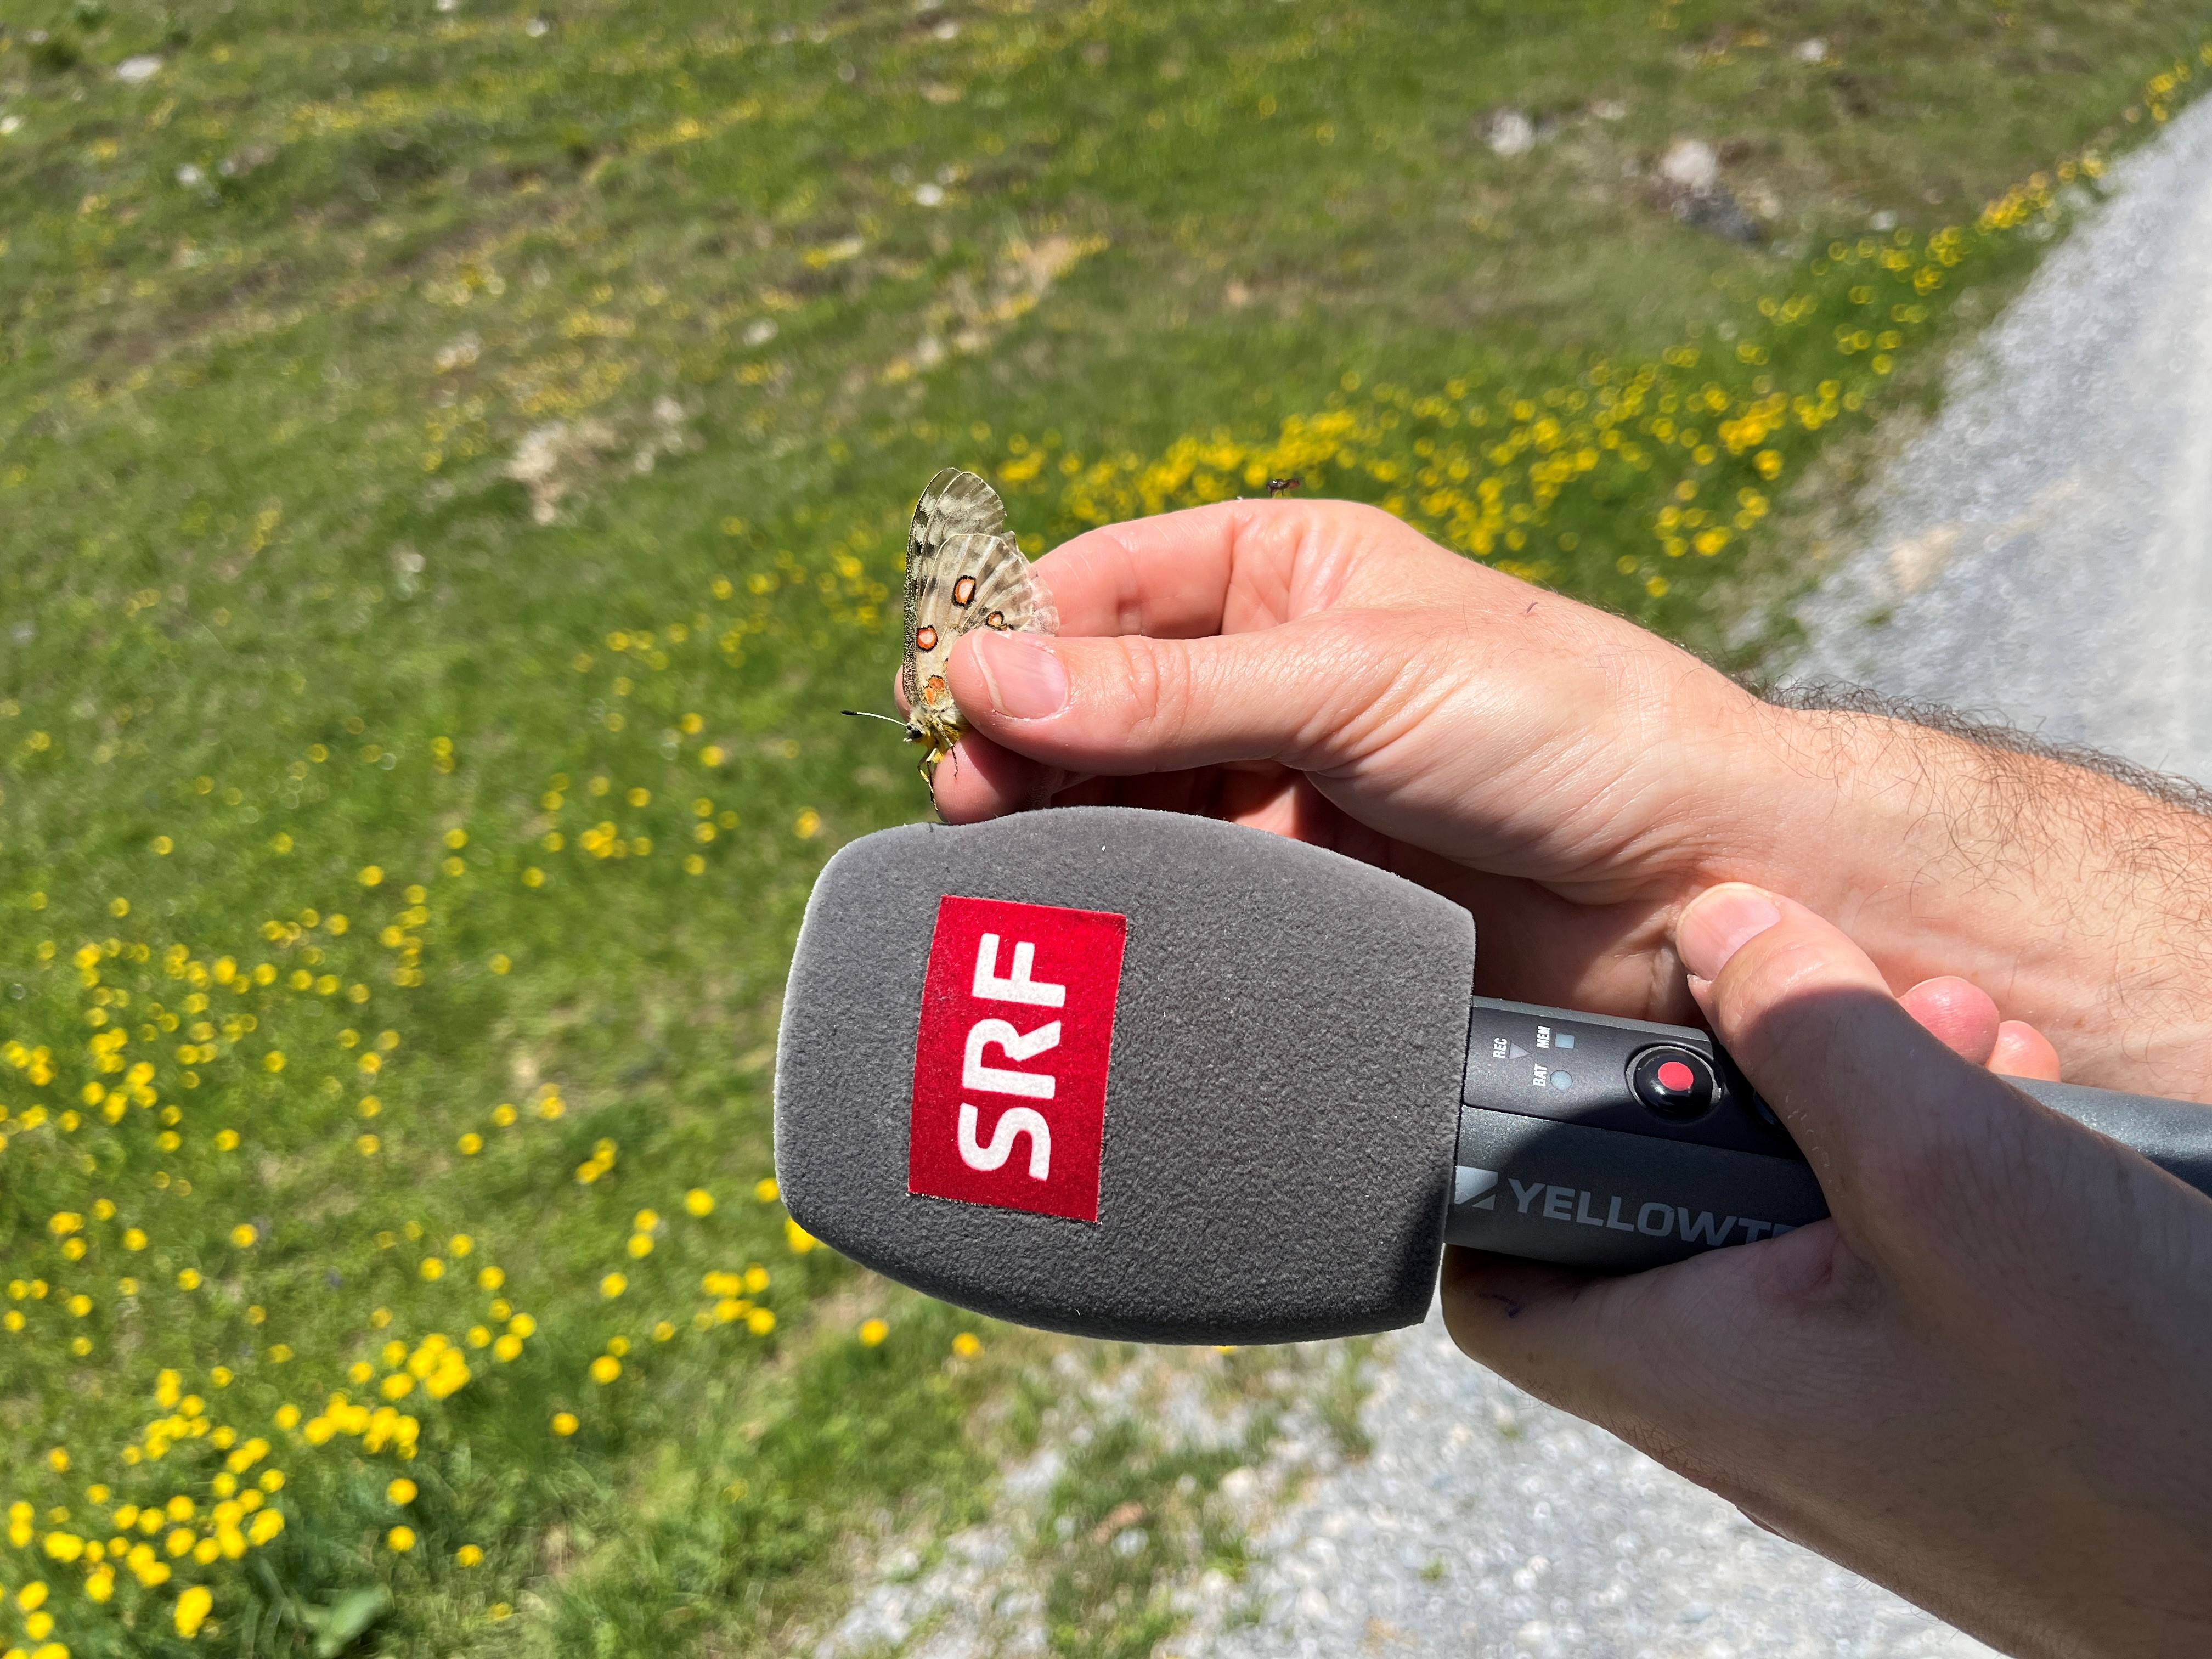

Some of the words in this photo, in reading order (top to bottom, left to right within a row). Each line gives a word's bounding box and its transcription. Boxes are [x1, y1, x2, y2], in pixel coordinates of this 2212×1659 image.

[1492, 1037, 1507, 1059] REC
[1536, 1025, 1550, 1049] MEM
[958, 933, 1066, 1181] SRF
[1532, 1063, 1547, 1087] BAT
